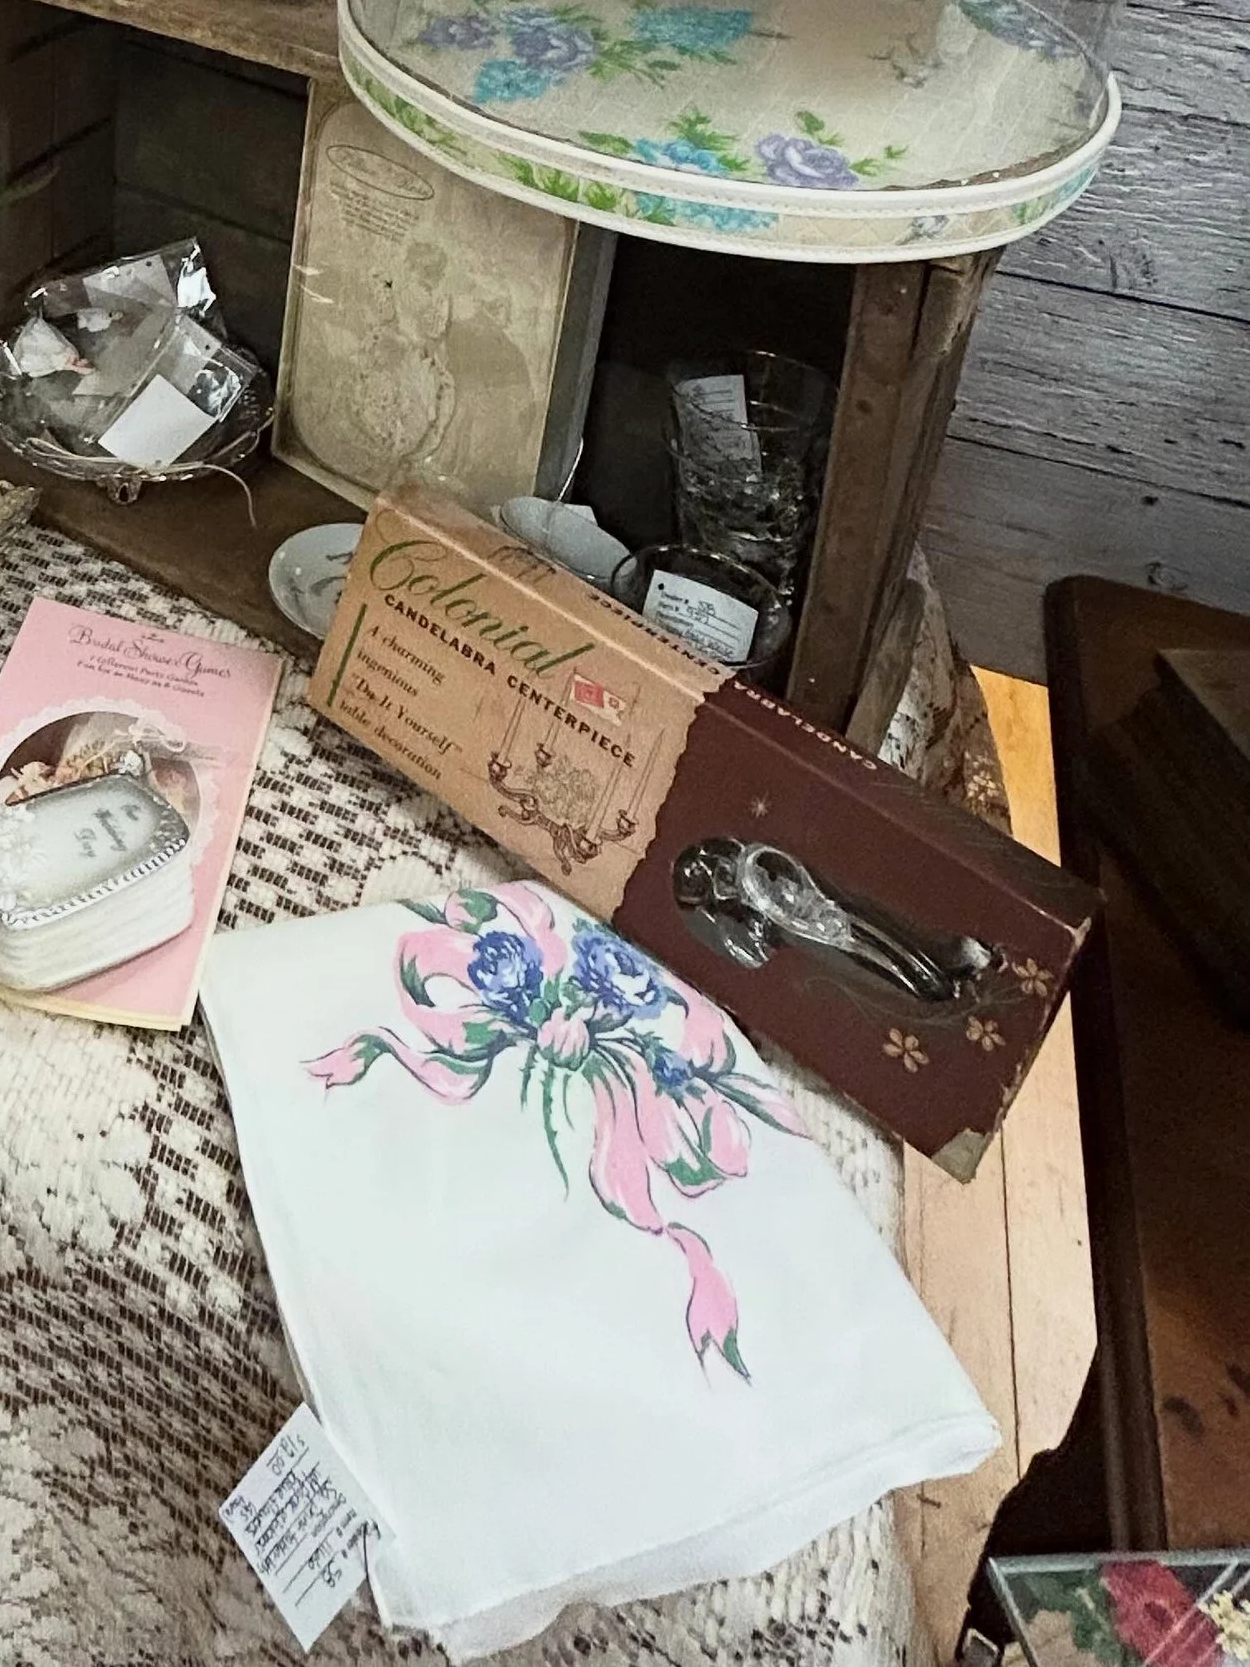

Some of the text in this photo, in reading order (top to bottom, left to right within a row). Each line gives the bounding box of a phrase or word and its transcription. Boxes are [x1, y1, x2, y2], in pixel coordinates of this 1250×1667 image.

[369, 538, 597, 680] Colonial
[68, 624, 122, 653] Bridal
[123, 638, 180, 666] Shower
[356, 649, 421, 698] ingenious
[368, 625, 447, 686] A charming
[384, 592, 637, 768] CANDELABRA CENTERPIECE
[373, 723, 443, 781] decoration
